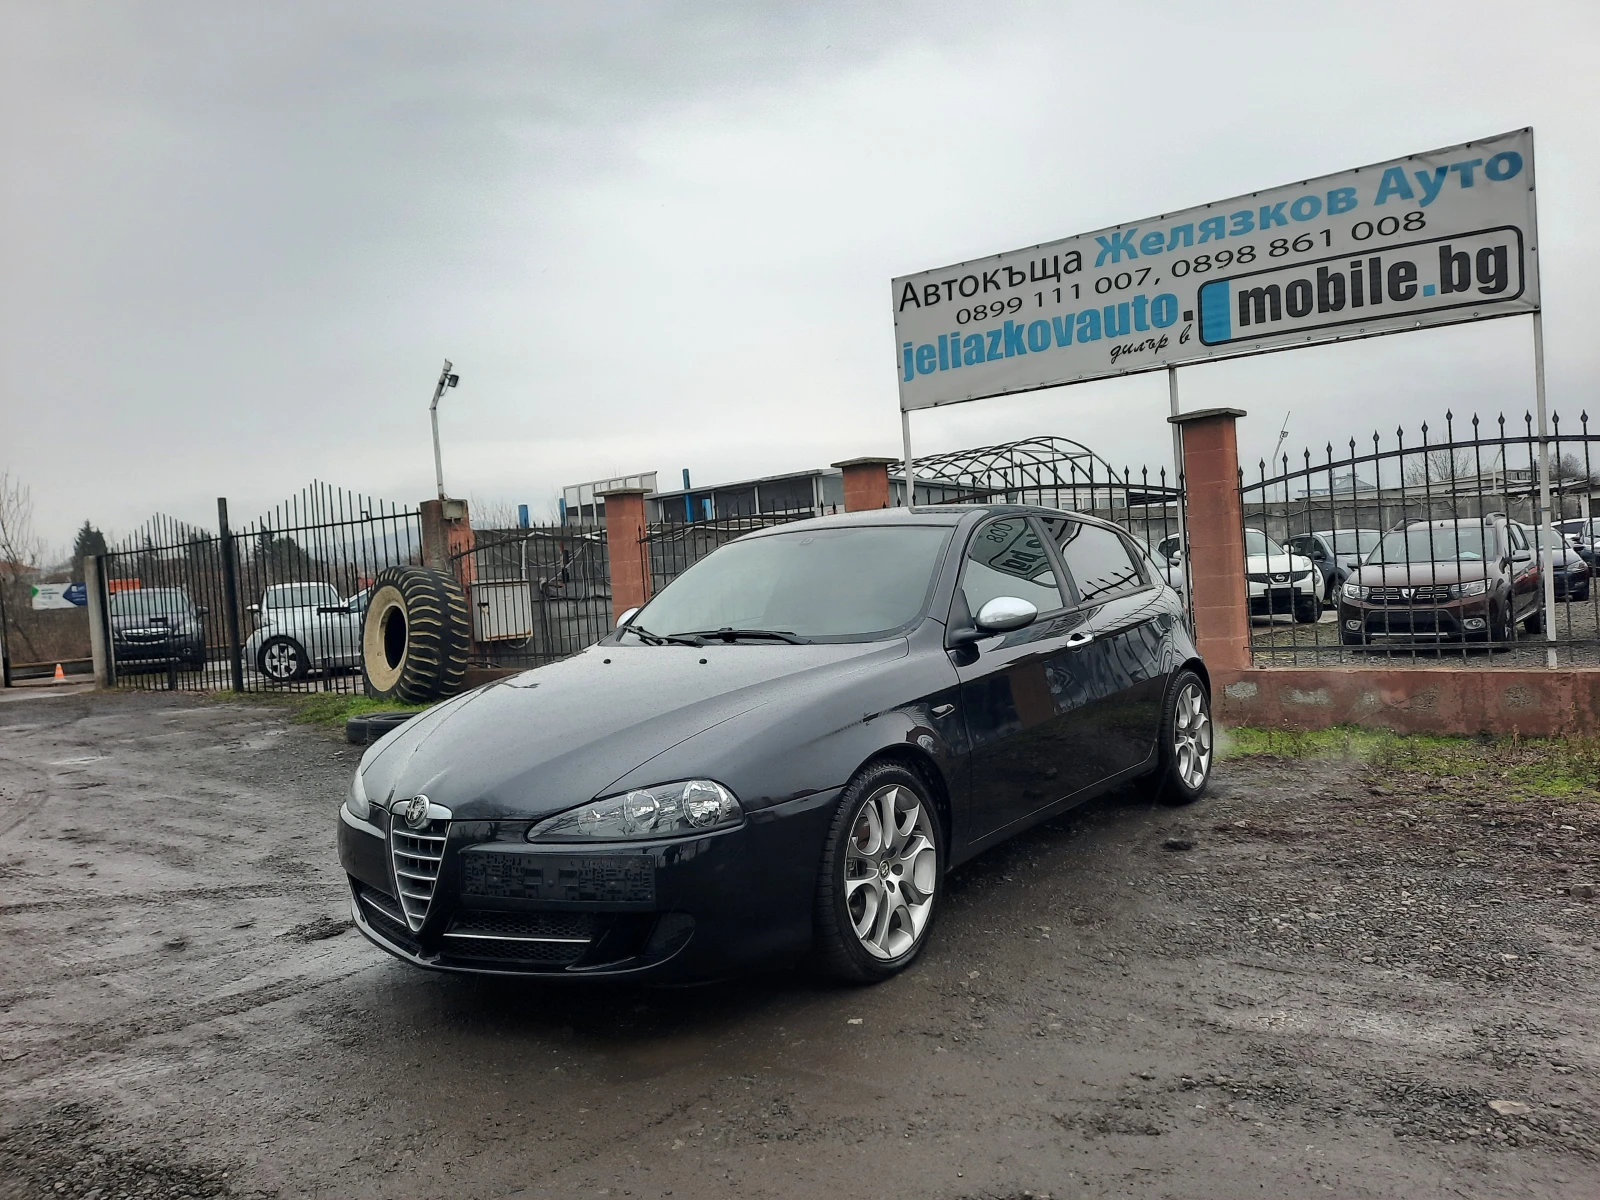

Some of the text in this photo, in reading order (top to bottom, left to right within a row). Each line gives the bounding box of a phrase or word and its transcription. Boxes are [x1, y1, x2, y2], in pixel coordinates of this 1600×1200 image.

[899, 151, 1523, 312] Автокъща Желязков Ауто
[956, 211, 1426, 325] 0899 111 007, 0898 861 008
[1238, 245, 1508, 326] mobile.bg
[1110, 323, 1192, 364] дилър в
